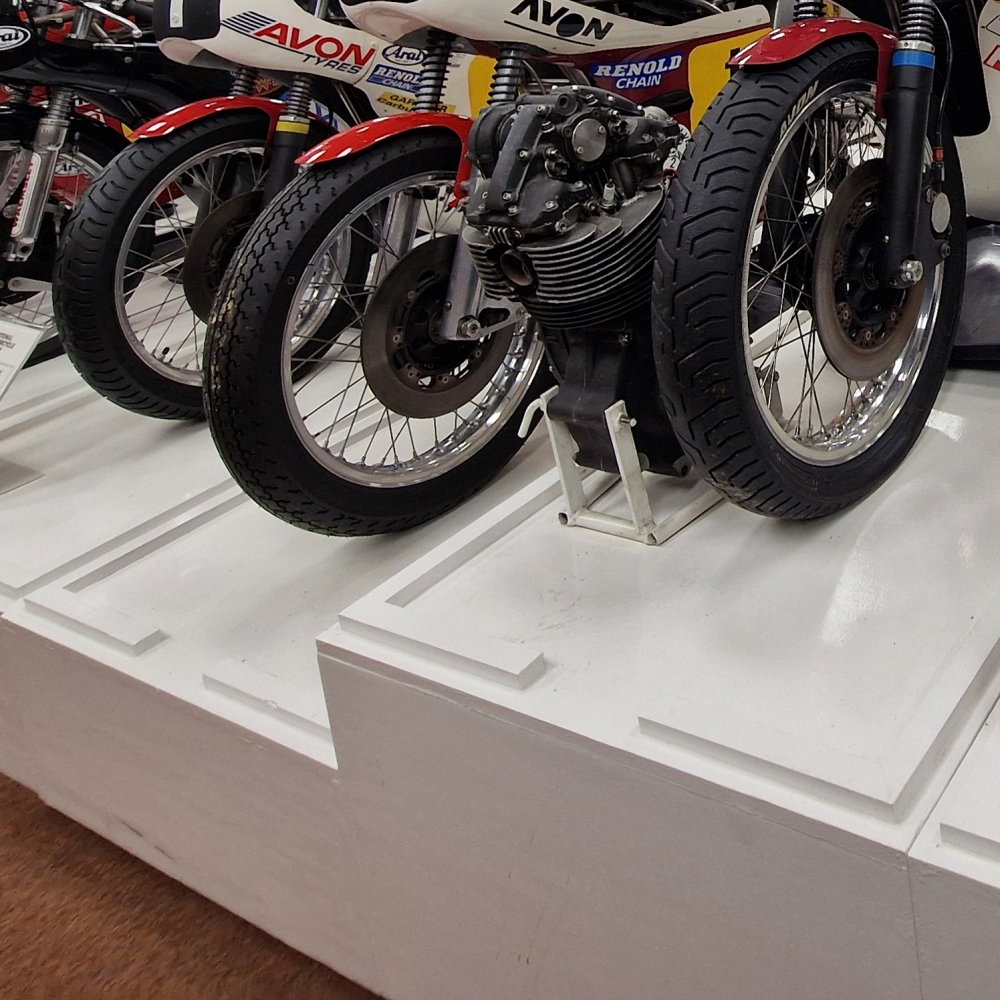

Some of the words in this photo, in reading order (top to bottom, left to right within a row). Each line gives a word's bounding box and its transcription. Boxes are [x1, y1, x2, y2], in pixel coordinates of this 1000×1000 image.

[254, 22, 377, 67] AVON
[302, 52, 363, 75] TYRES
[594, 55, 682, 77] RENOLD
[374, 67, 421, 84] RENOL
[615, 74, 661, 89] CHAIN
